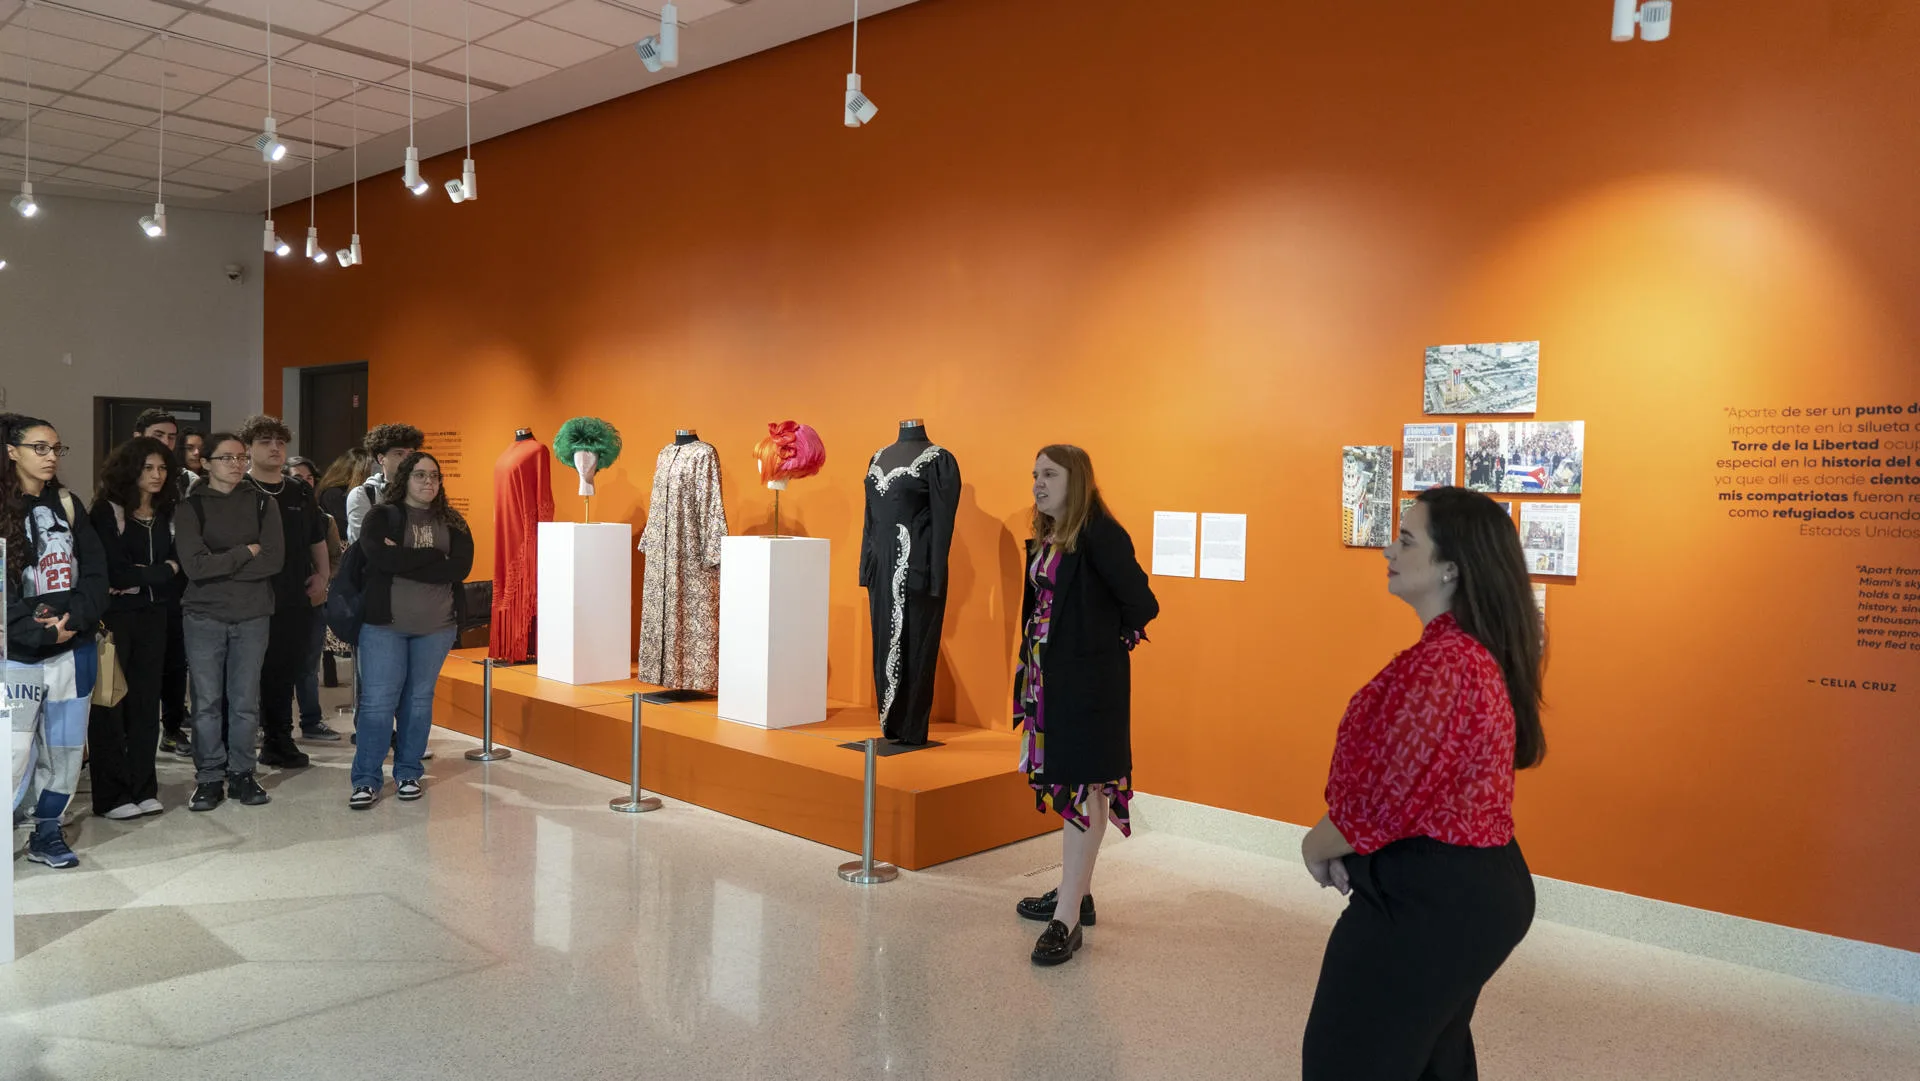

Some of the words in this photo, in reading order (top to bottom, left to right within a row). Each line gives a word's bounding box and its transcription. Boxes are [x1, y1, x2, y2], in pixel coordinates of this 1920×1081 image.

[1781, 406, 1801, 417] de
[1806, 407, 1827, 417] ser
[1832, 407, 1851, 416] un
[1855, 405, 1903, 418] punto
[1728, 423, 1810, 438] importante
[1815, 424, 1834, 433] en
[1838, 421, 1853, 433] la
[1857, 421, 1910, 433] silueta
[1731, 440, 1768, 451] Torre
[1772, 440, 1791, 451] de
[1795, 439, 1809, 450] la
[1813, 438, 1879, 451] Libertad
[1716, 456, 1777, 470] especial
[1781, 459, 1799, 468] en
[1804, 456, 1817, 468] la
[1822, 456, 1881, 468] historia
[1886, 455, 1911, 467] del
[1714, 475, 1731, 486] ya
[1736, 475, 1764, 487] que
[1793, 475, 1809, 485] es
[1814, 473, 1866, 485] donde
[1718, 490, 1743, 501] mis
[1746, 490, 1848, 504] compatriotas
[1853, 491, 1904, 503] fueron
[1728, 508, 1769, 518] como
[1772, 507, 1855, 521] refugiados
[1859, 508, 1920, 521] cuando
[1800, 524, 1861, 538] Estados
[46, 566, 72, 591] 23
[1859, 577, 1902, 587] Miami's
[1858, 590, 1889, 600] holds
[1858, 602, 1898, 613] history,
[1857, 614, 1870, 623] of
[1857, 628, 1885, 636] were
[1857, 639, 1881, 650] they
[1885, 640, 1906, 650] fled
[1820, 677, 1857, 689] CELIA
[1862, 681, 1897, 693] CRUZ
